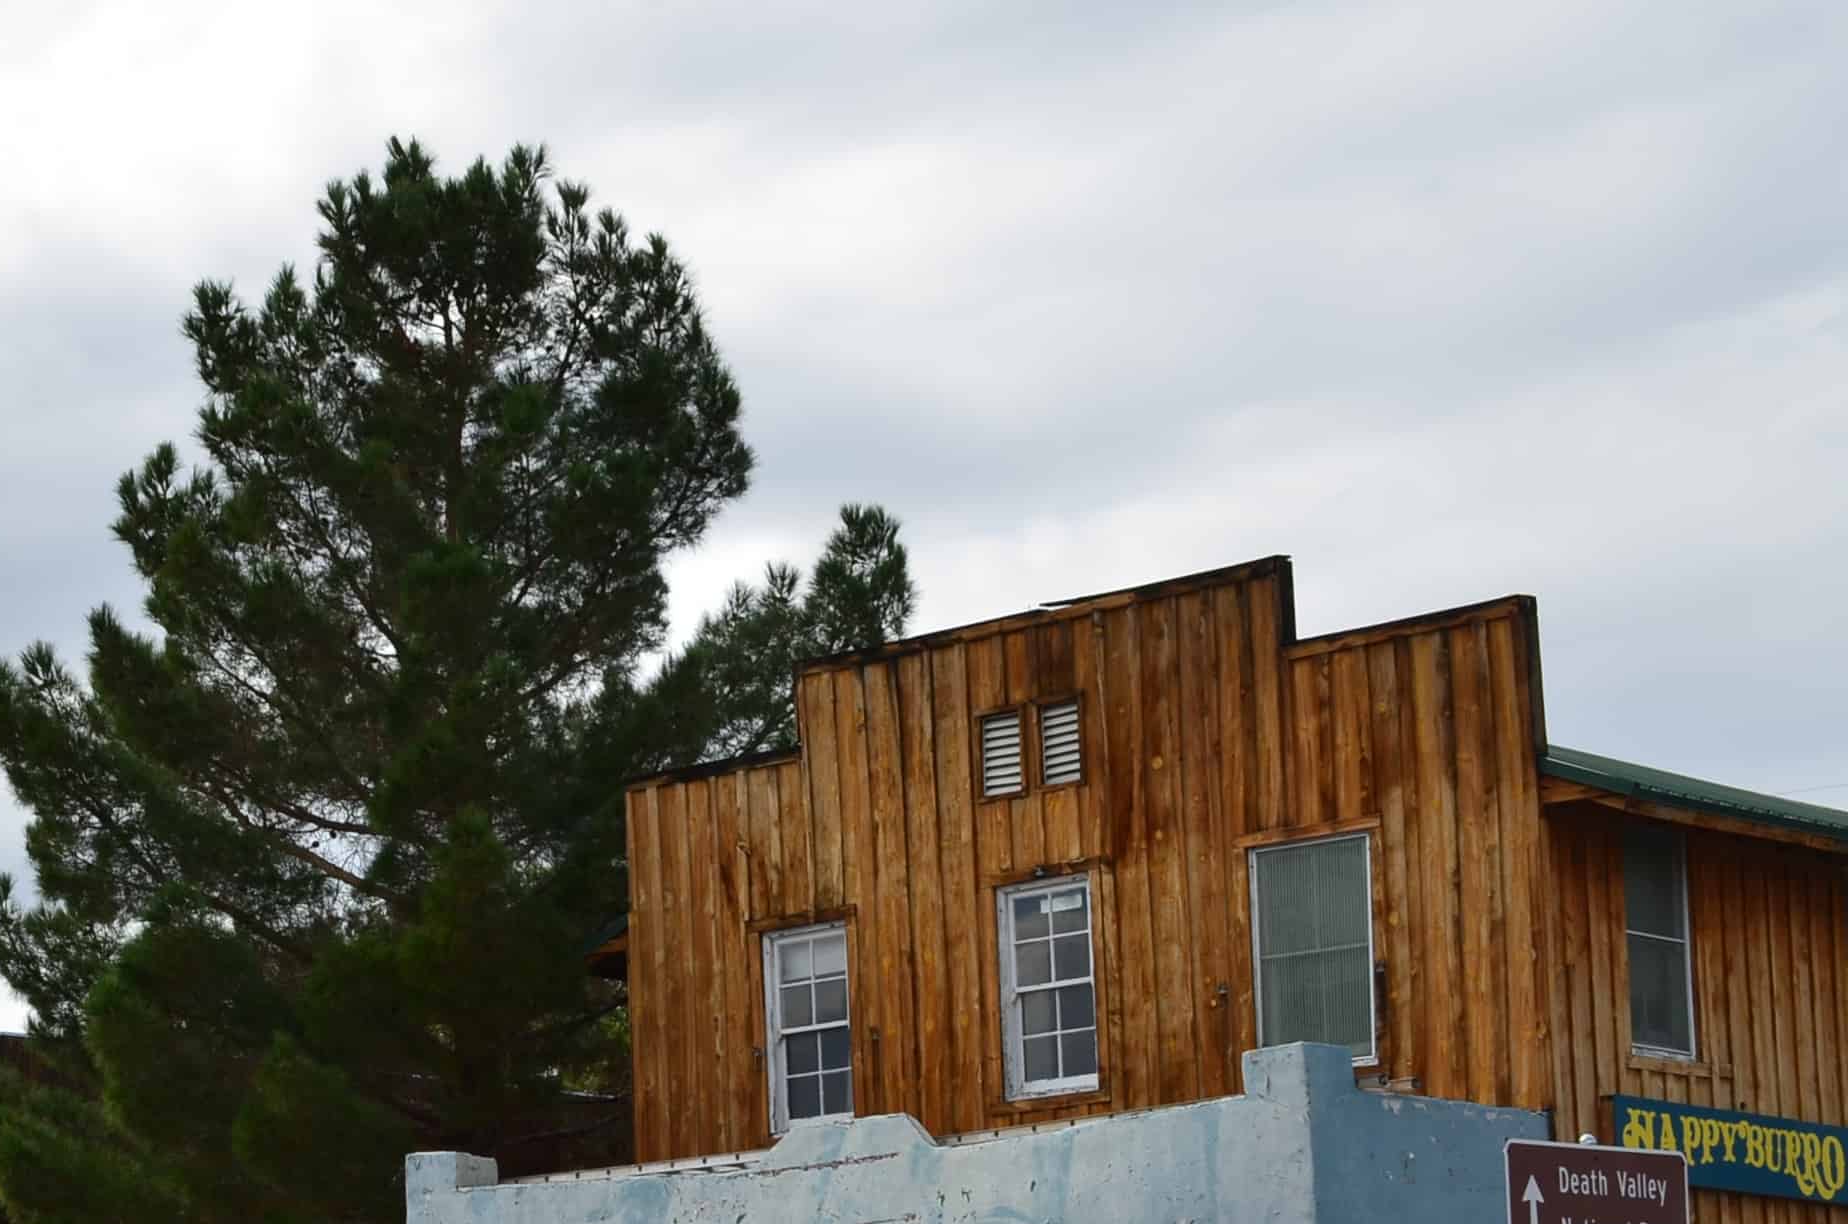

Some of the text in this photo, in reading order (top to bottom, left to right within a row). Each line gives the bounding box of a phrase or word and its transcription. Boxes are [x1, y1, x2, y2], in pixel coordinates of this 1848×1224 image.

[1559, 1167, 1668, 1206] Death Valley
[1623, 1107, 1846, 1200] HAPPY BURRO
